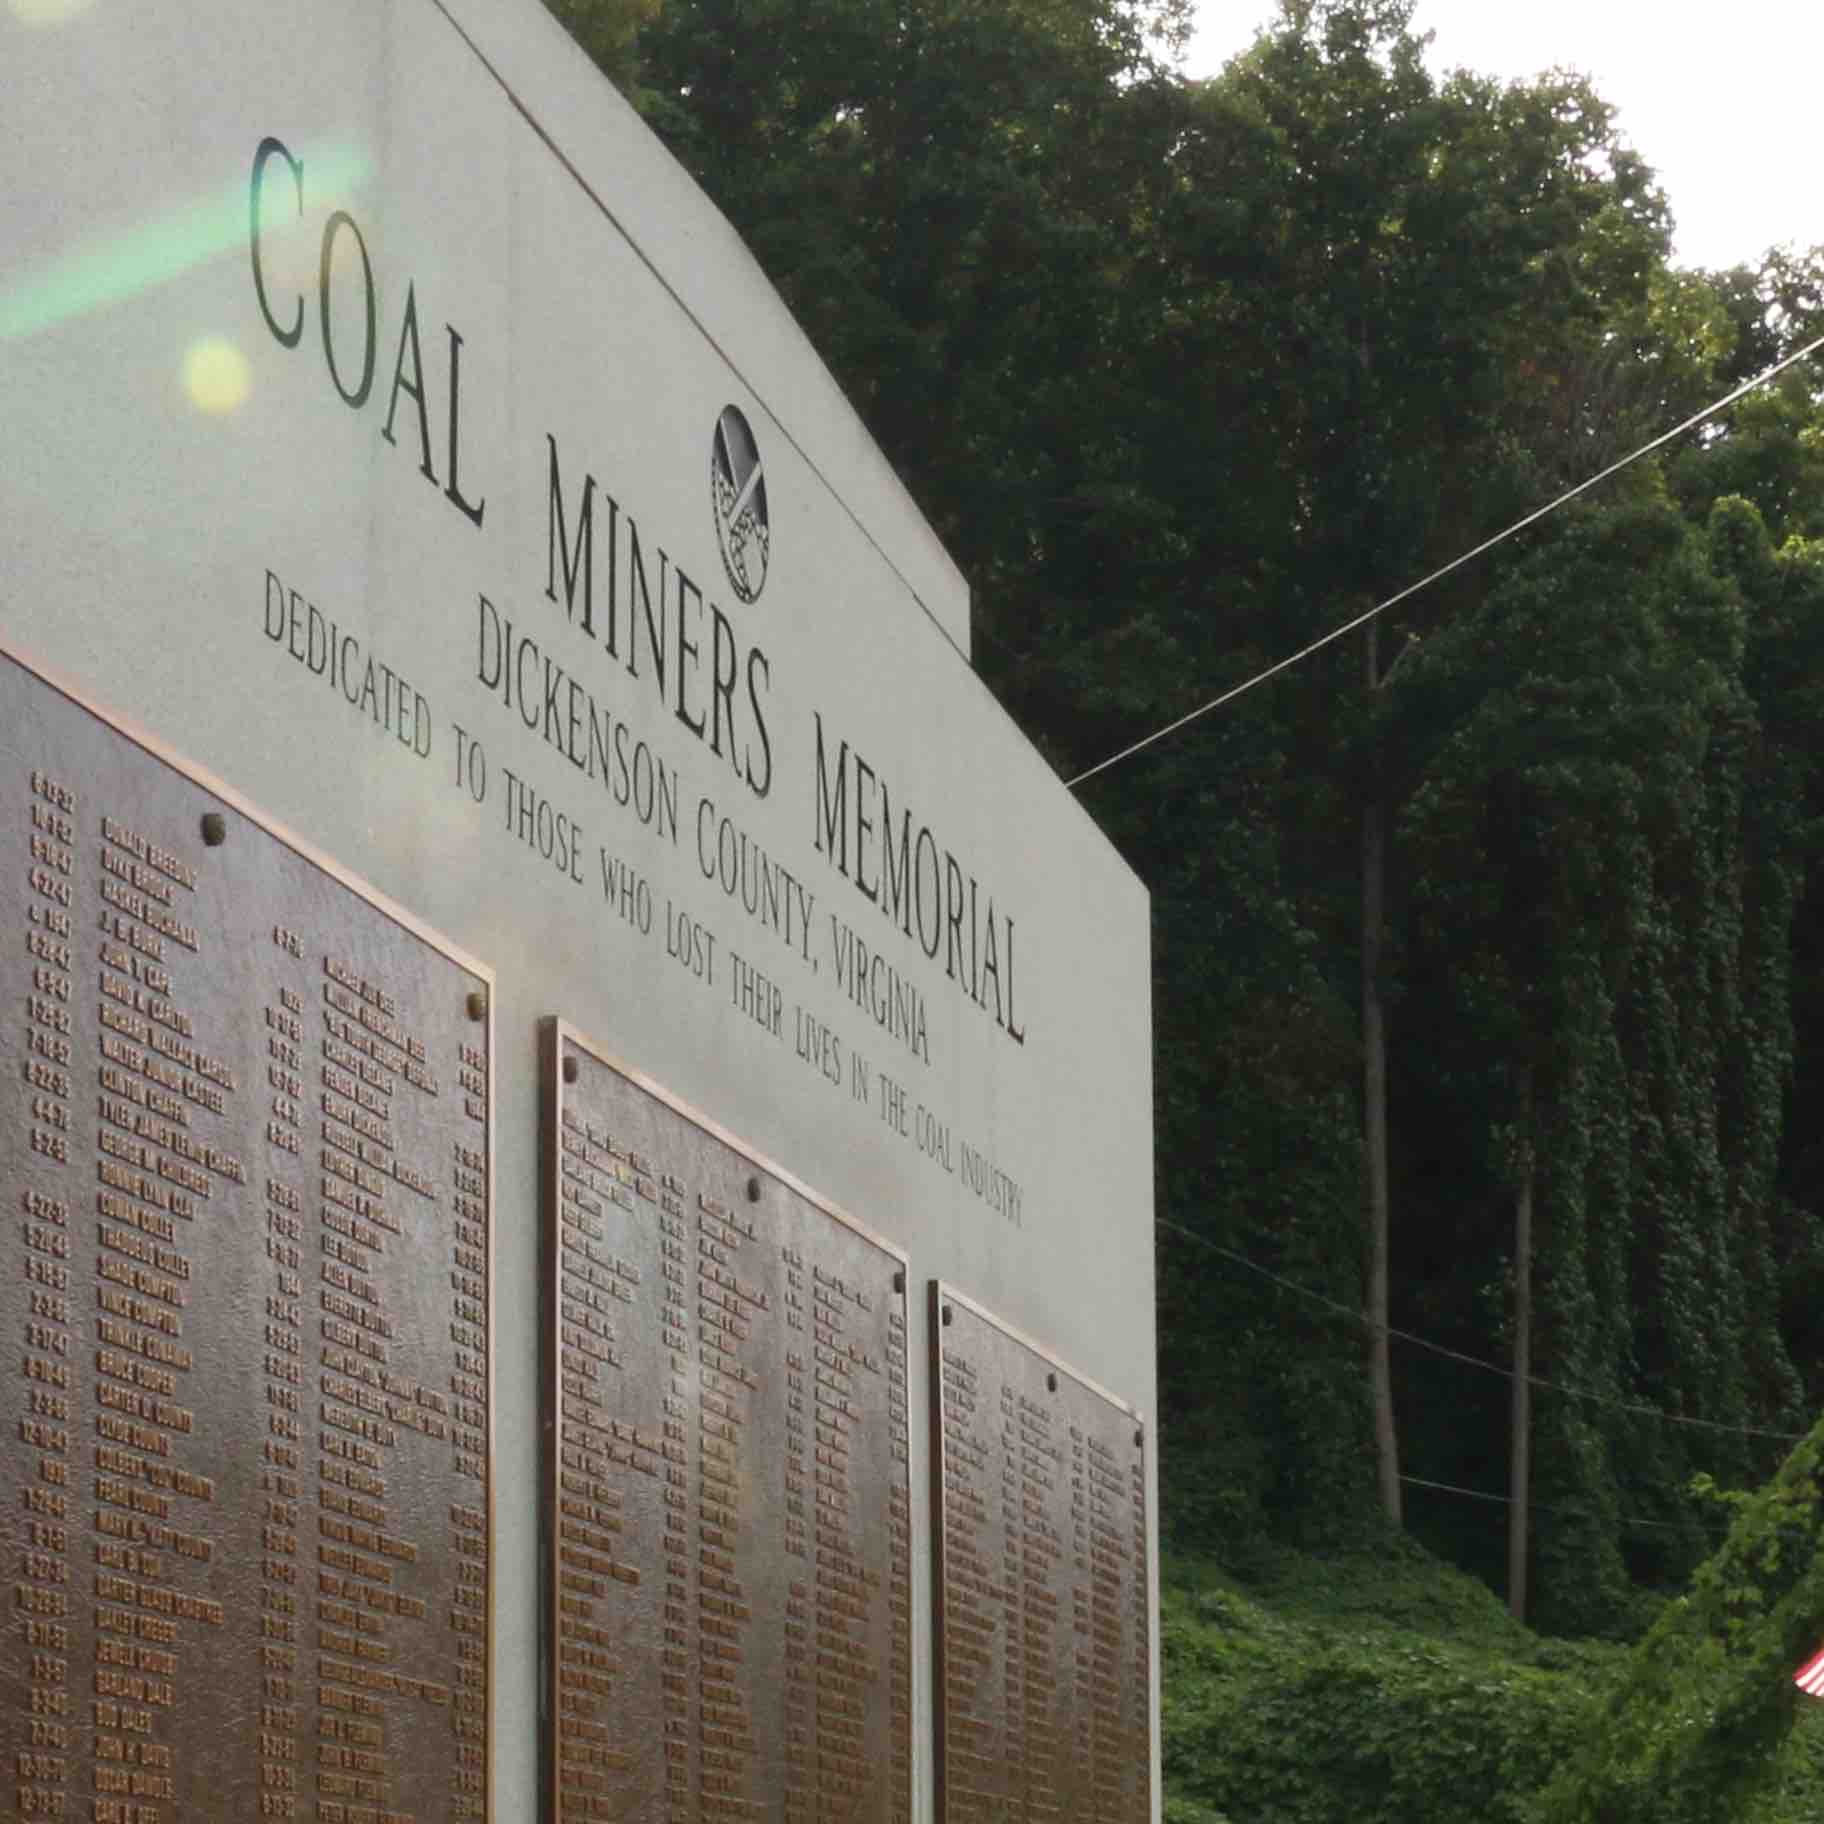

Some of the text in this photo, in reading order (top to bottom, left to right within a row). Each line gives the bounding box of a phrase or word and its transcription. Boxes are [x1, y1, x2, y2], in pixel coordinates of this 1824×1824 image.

[249, 137, 1025, 1045] COAL MINERS MEMORIAL
[264, 568, 1023, 1228] DEDICATED TO THOSE WHO LOST THEIR LIVES IN THE COAL INDUSTRY
[479, 595, 929, 1064] DICKENSON COUNTY, VIRGINIA
